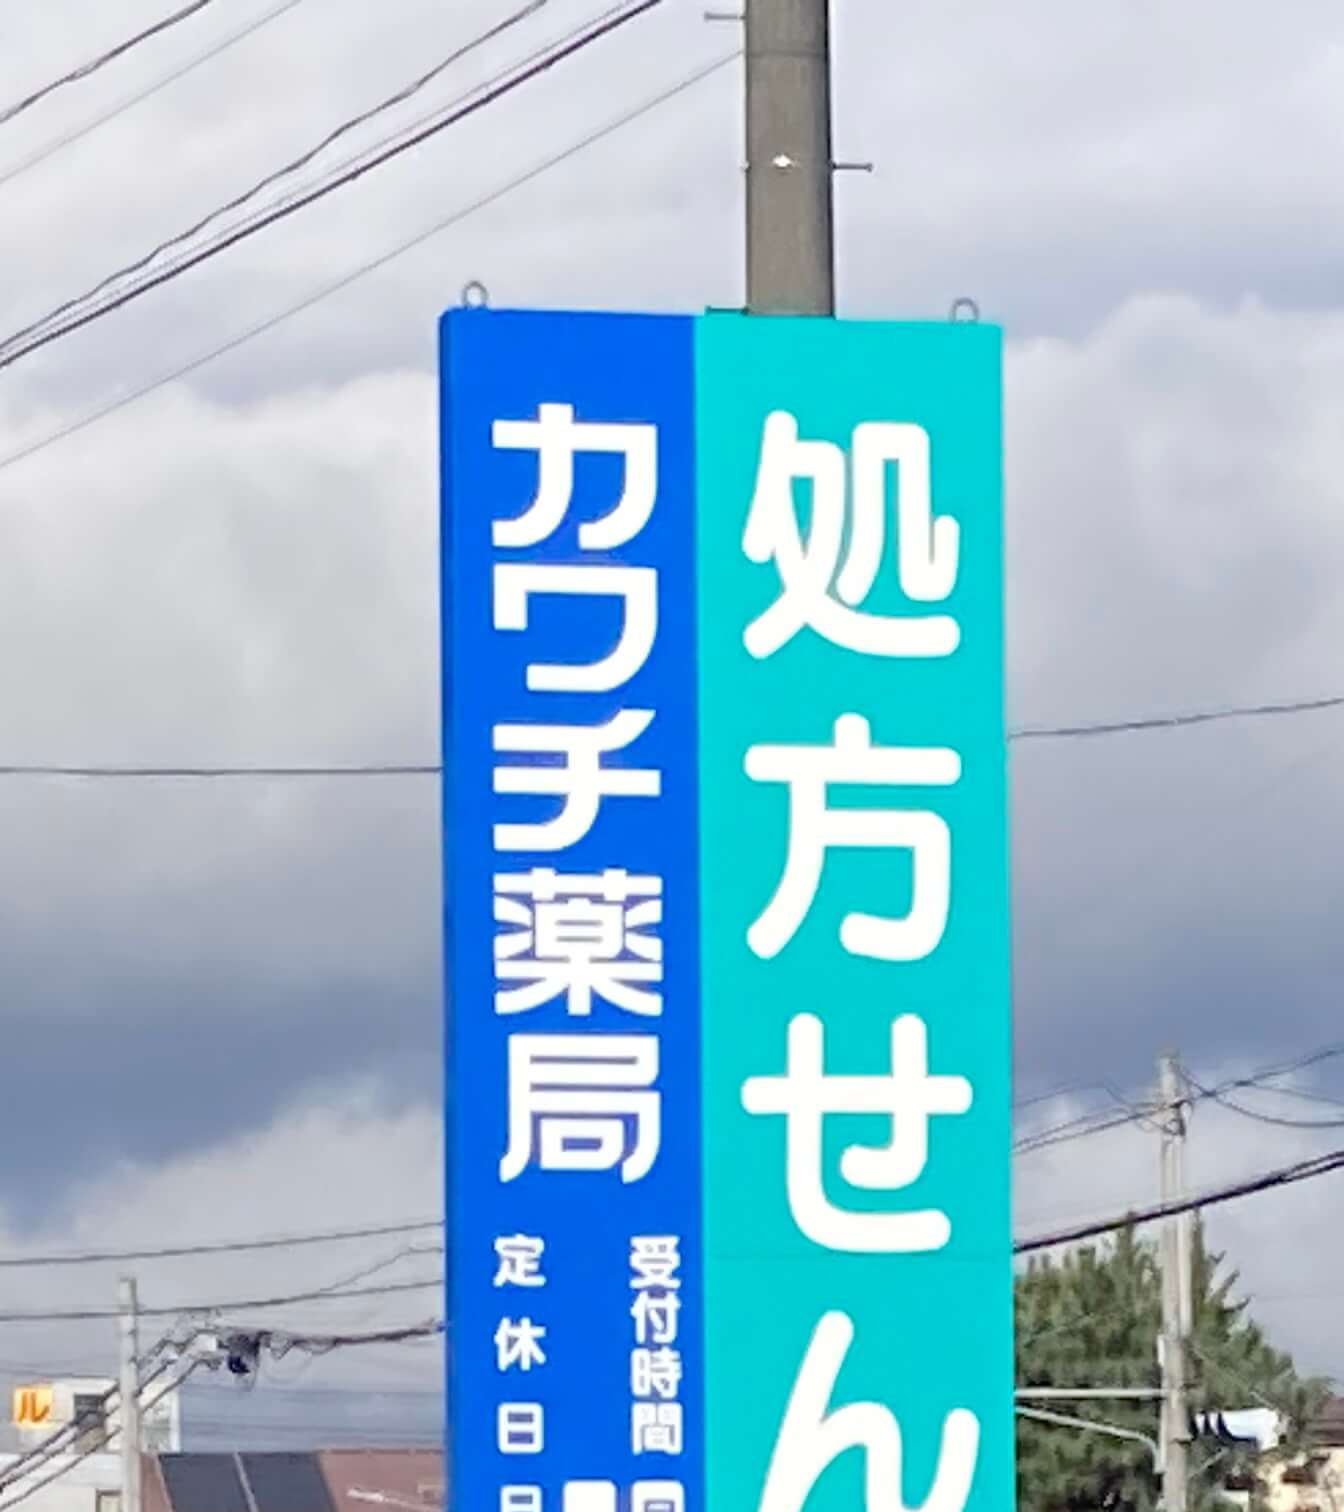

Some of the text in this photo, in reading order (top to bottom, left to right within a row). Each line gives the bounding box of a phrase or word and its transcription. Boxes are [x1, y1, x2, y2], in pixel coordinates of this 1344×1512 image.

[492, 402, 663, 1184] カワチ薬局
[493, 1233, 546, 1456] 定休日
[629, 1235, 684, 1456] 受付時間
